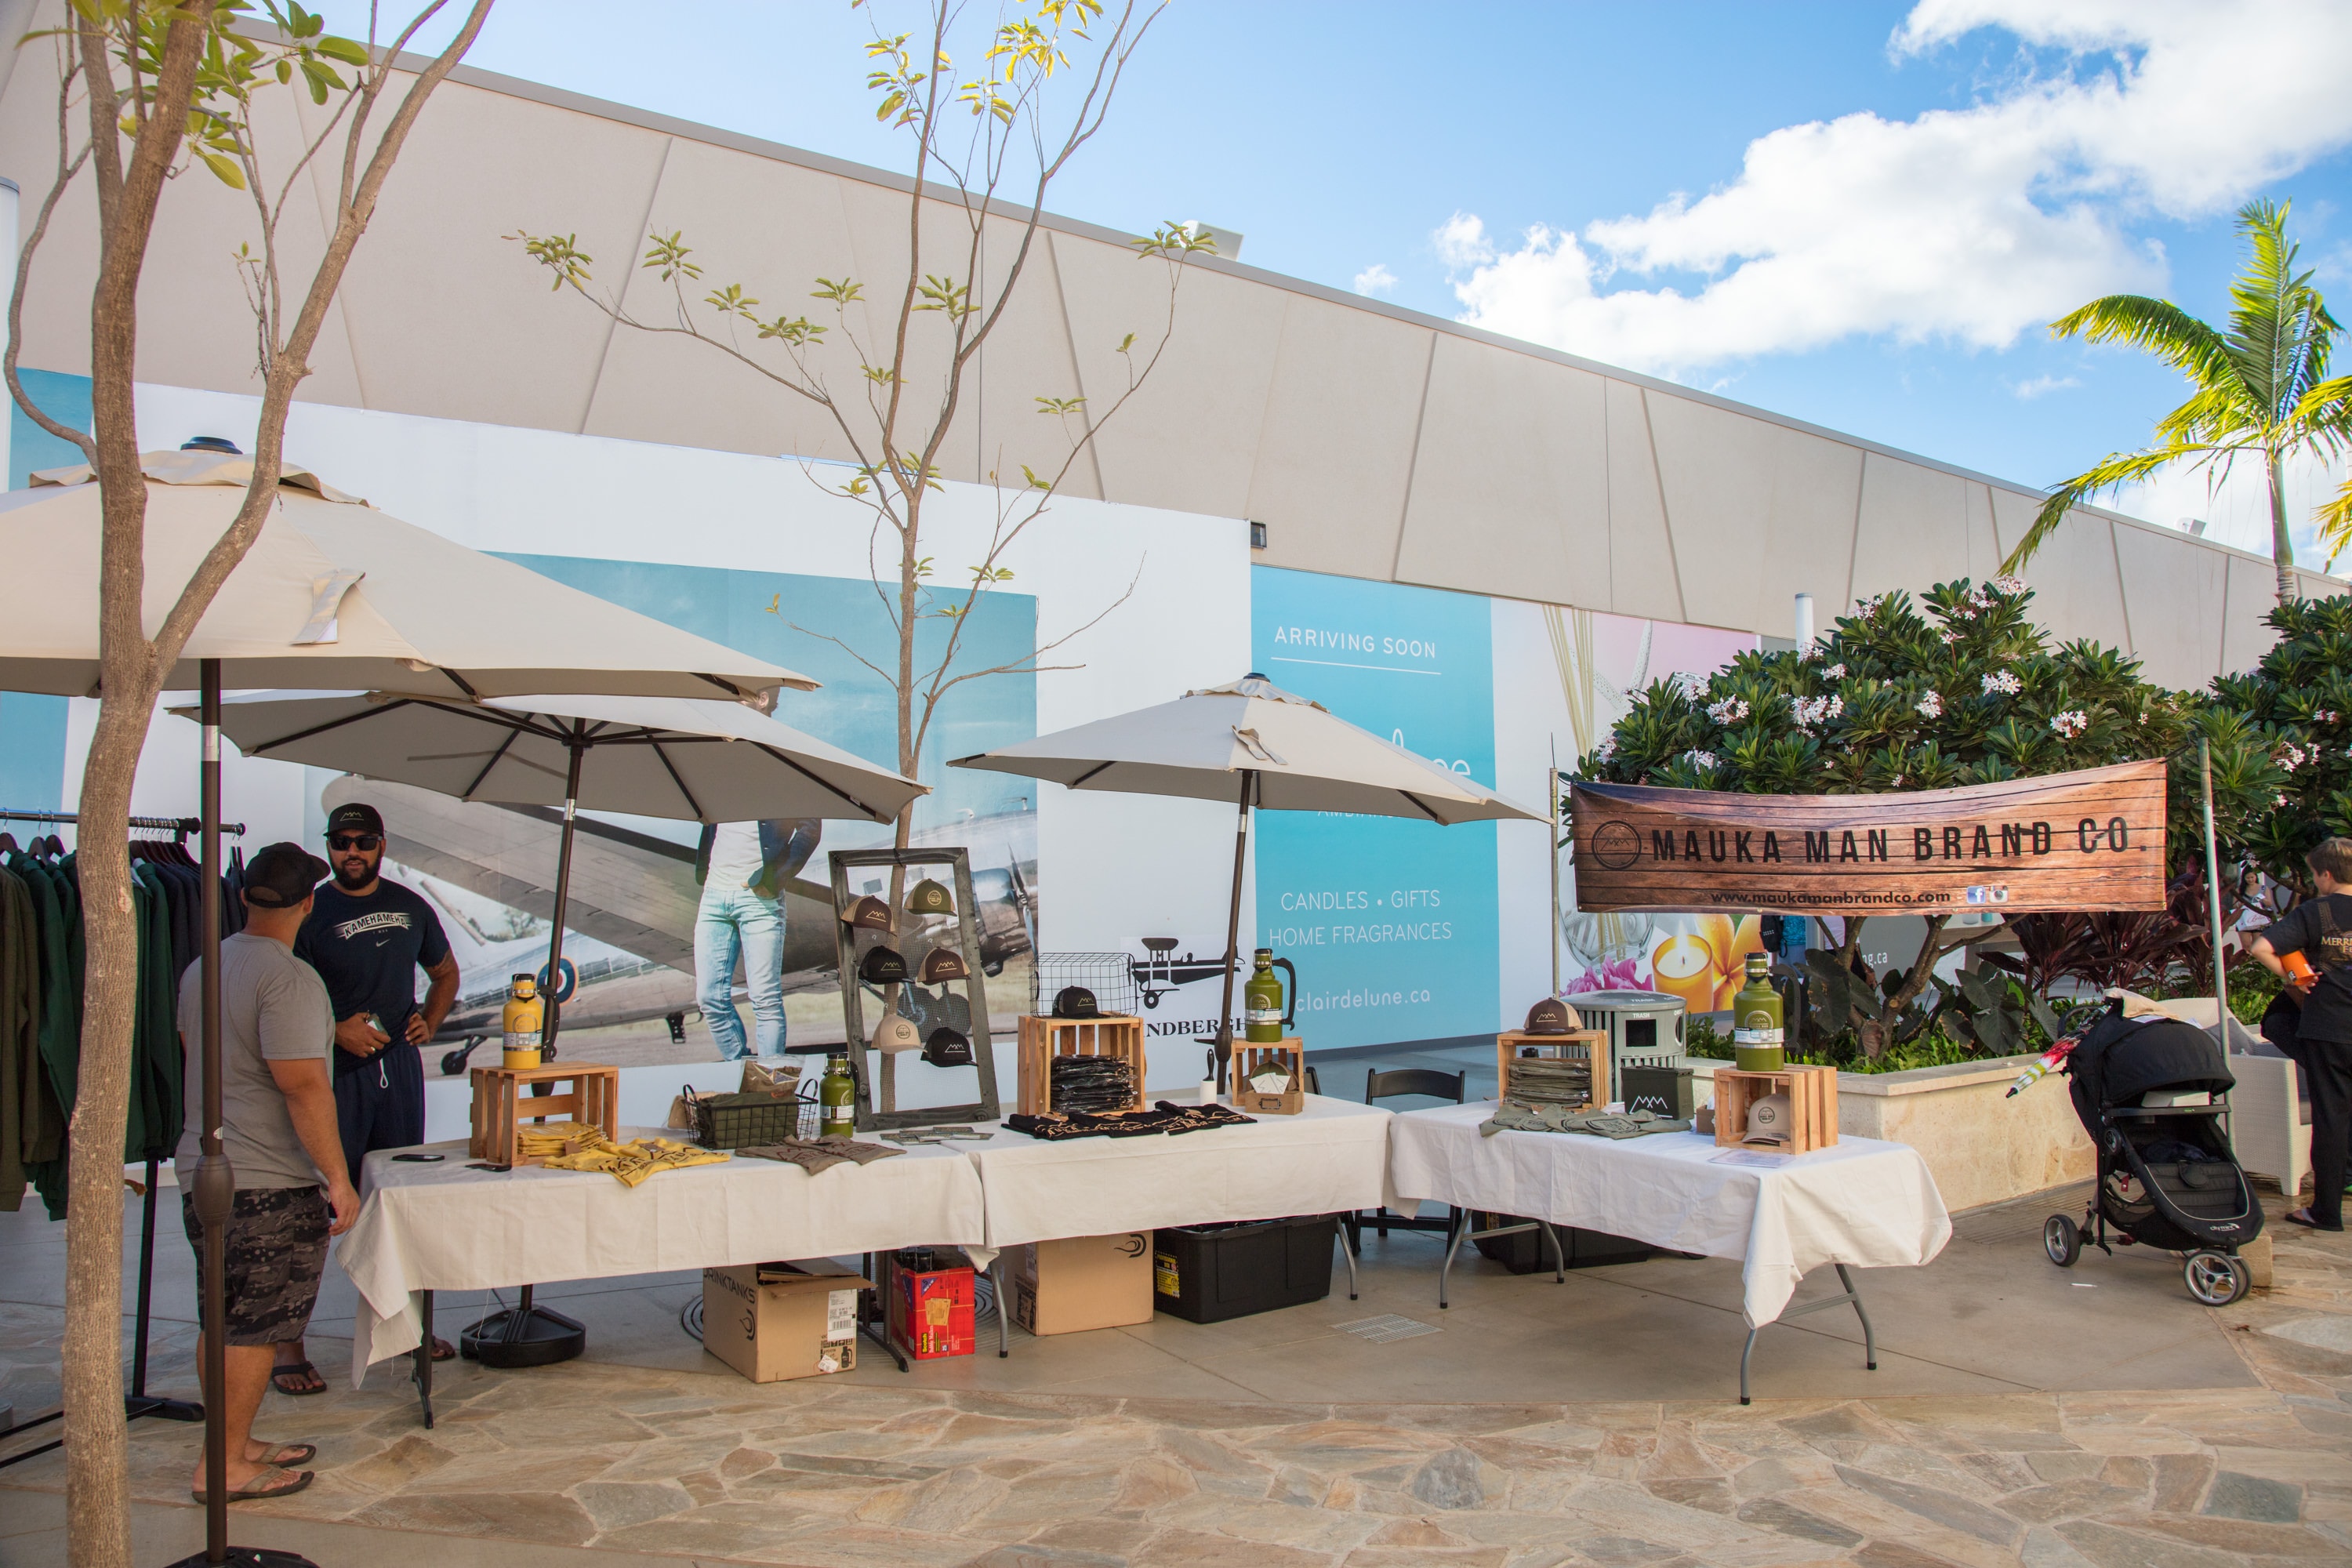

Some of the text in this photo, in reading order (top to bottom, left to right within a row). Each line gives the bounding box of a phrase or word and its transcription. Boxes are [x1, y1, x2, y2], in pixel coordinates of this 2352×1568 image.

[1274, 626, 1436, 659] ARRIVING SOON
[1652, 829, 1781, 863] MAUKA
[1805, 829, 1888, 863] MAN
[1914, 822, 2051, 861] BRAND
[1280, 890, 1441, 911] CANDLES GIFTS
[1711, 890, 1951, 905] www.maukamanbrandco.com
[345, 913, 406, 938] KAMEHAMEHA
[1269, 922, 1452, 947] HOME FRAGRANCES
[1295, 988, 1431, 1012] clairdelune.ca
